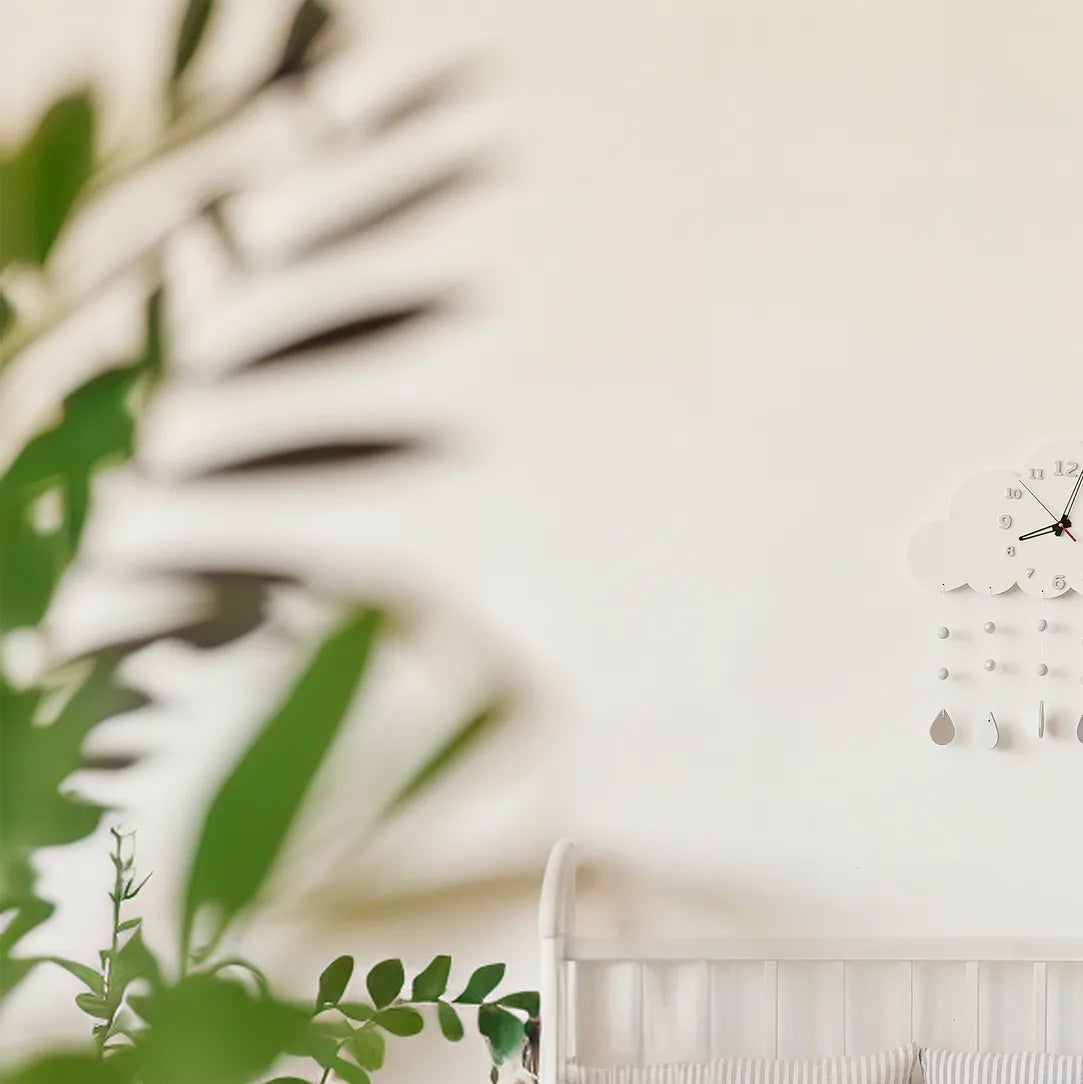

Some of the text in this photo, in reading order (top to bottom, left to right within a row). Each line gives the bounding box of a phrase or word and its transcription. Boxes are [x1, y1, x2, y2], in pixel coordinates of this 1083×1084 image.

[1028, 468, 1044, 480] 11
[1054, 461, 1079, 477] 12
[1006, 488, 1022, 500] 10
[998, 515, 1013, 530] 9
[1006, 546, 1016, 557] 8
[1026, 568, 1035, 579] 7
[1052, 575, 1065, 590] 6
